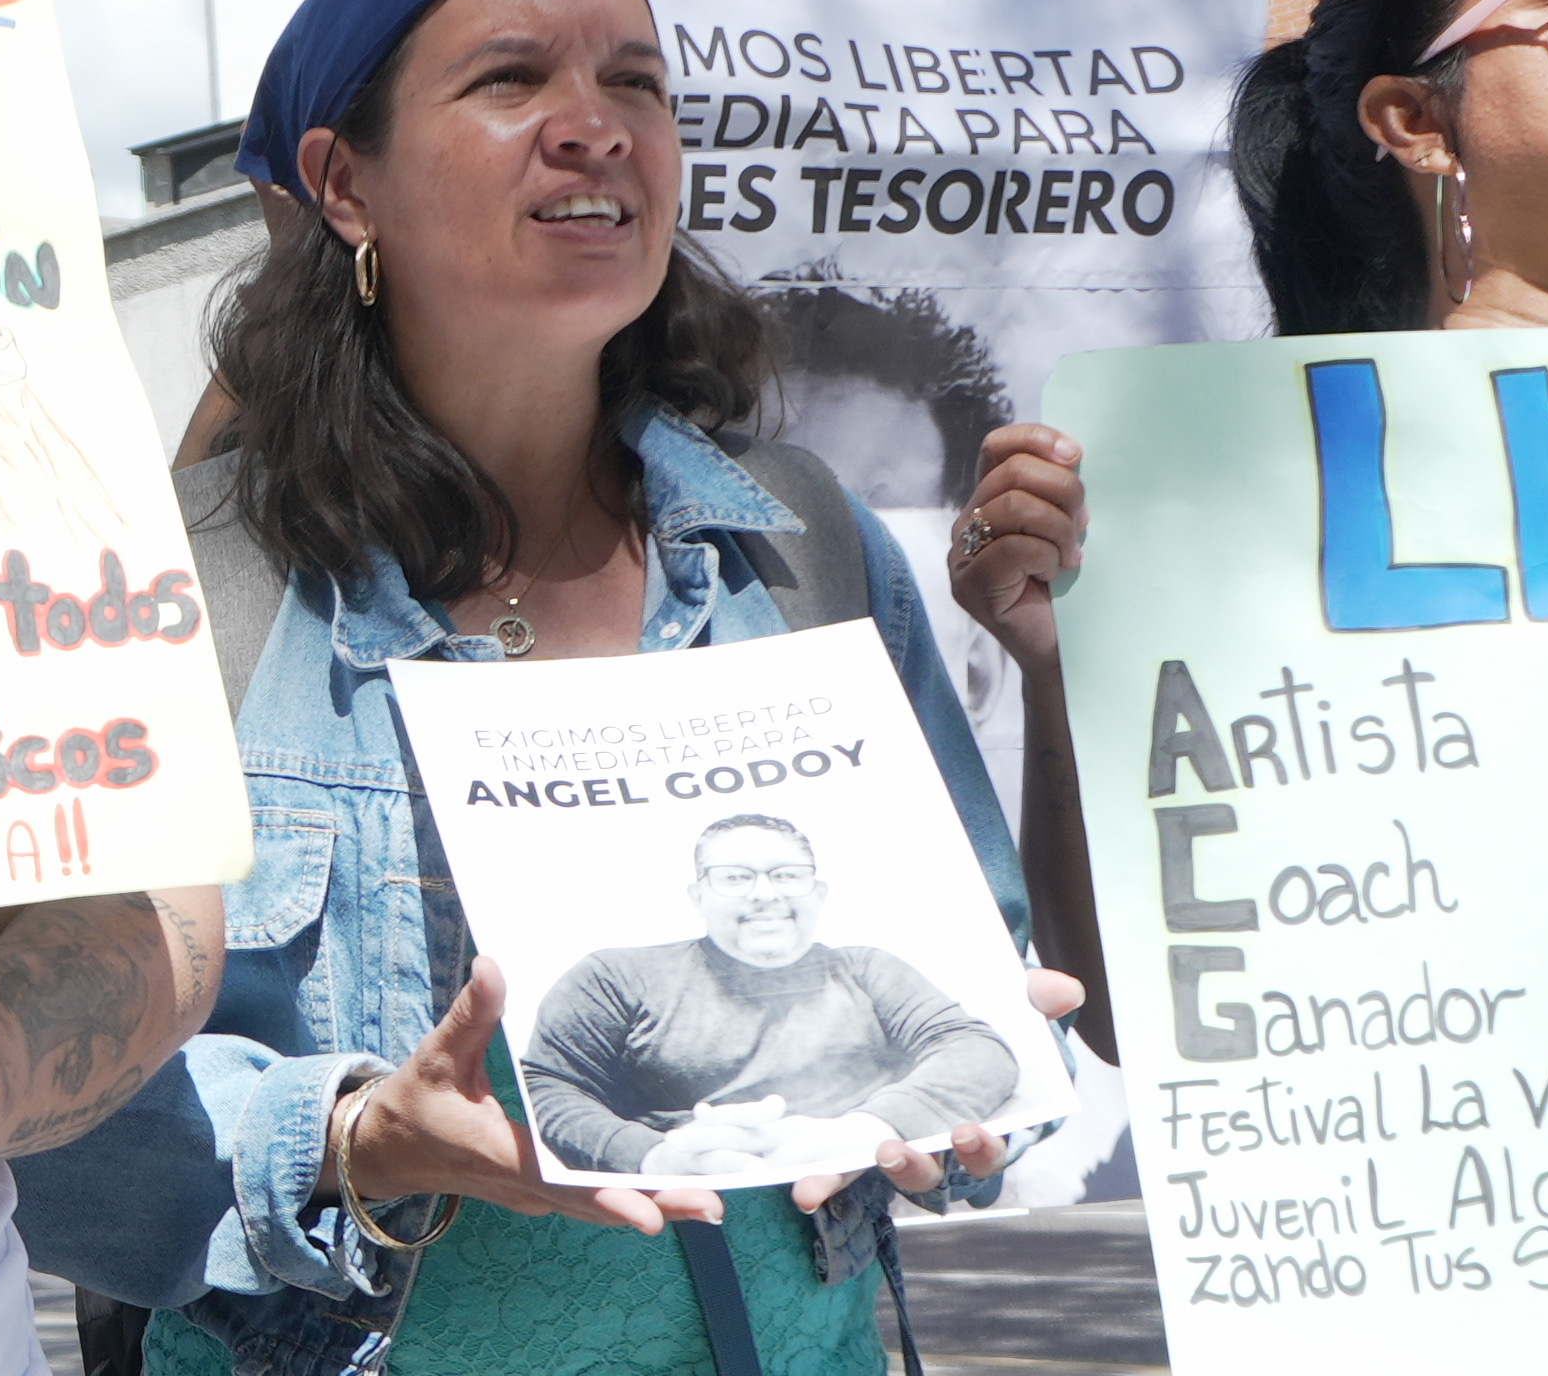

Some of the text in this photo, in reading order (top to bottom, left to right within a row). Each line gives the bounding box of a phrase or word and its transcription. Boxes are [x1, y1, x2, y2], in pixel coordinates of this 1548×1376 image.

[848, 39, 1184, 98] LIBERTAD
[671, 94, 1156, 156] EDIATA PARA
[679, 164, 1174, 237] ES TESORERO
[475, 696, 833, 750] EXIGIMOS LIBERTAD
[501, 726, 814, 774] INMEDIATA PARA
[1148, 656, 1480, 799] Artista
[465, 739, 867, 809] ANGEL GODOY
[1152, 804, 1459, 935] Coach
[1168, 944, 1527, 1064] Ganador
[1419, 1063, 1487, 1135] La
[1190, 1230, 1365, 1307] zando
[1384, 1221, 1493, 1298] Tus
